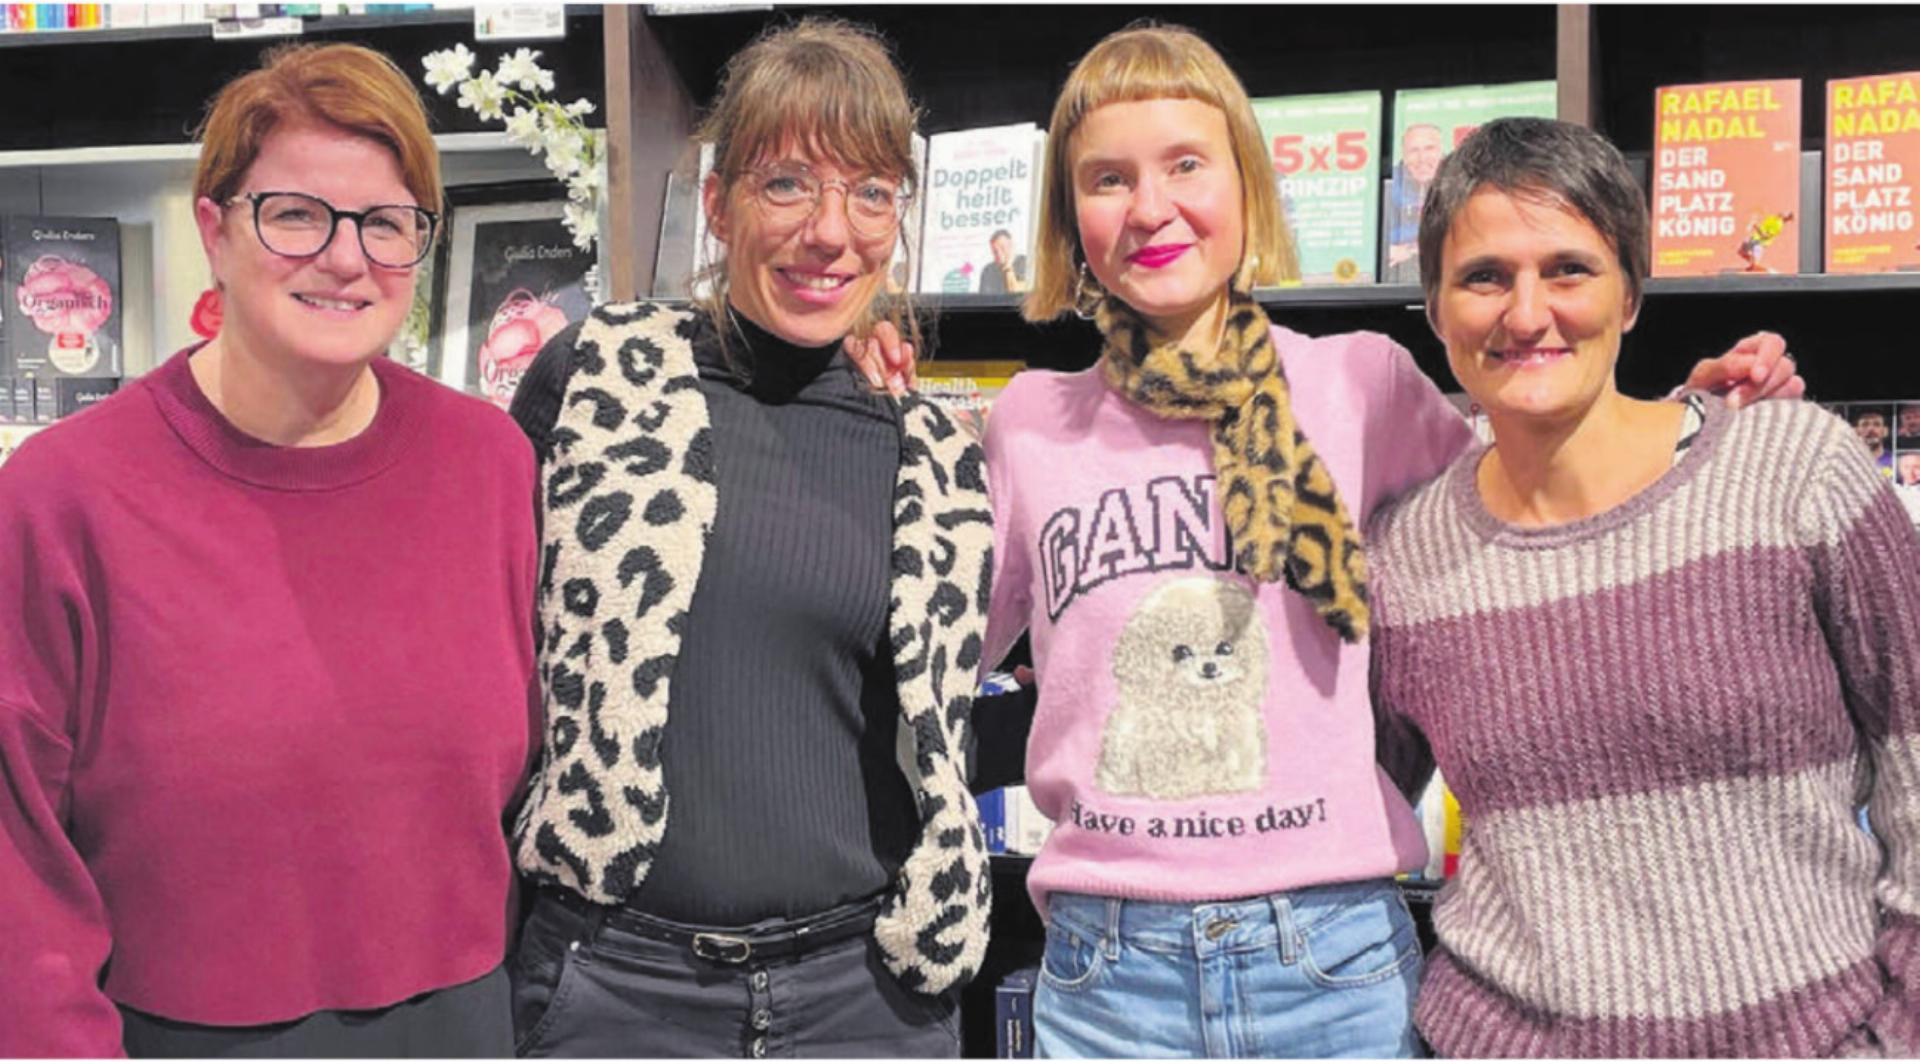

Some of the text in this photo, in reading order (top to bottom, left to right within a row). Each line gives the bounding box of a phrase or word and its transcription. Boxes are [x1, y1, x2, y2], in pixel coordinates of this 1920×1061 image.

[1662, 87, 1780, 115] RAFAEL
[1833, 80, 1920, 109] RAFA
[1661, 115, 1766, 143] NADAL
[1833, 108, 1920, 137] NADA
[1273, 131, 1369, 173] 5x5
[1660, 146, 1708, 168] DER
[1832, 140, 1884, 163] DER
[933, 158, 1028, 190] Doppelt
[1659, 169, 1726, 190] SAND
[1832, 163, 1903, 188] SAND
[956, 185, 1013, 209] heilt
[1279, 178, 1366, 199] RINZIP
[1832, 186, 1912, 211] PLATZ
[1659, 192, 1734, 214] PLATZ
[941, 207, 1020, 230] besser
[1659, 212, 1736, 238] KÖNIG
[1832, 208, 1914, 236] KÖNIG
[537, 245, 573, 260] Enders
[1038, 474, 1246, 624] GAN
[1147, 816, 1168, 838] a
[1173, 810, 1246, 838] nice
[1255, 797, 1326, 834] day!
